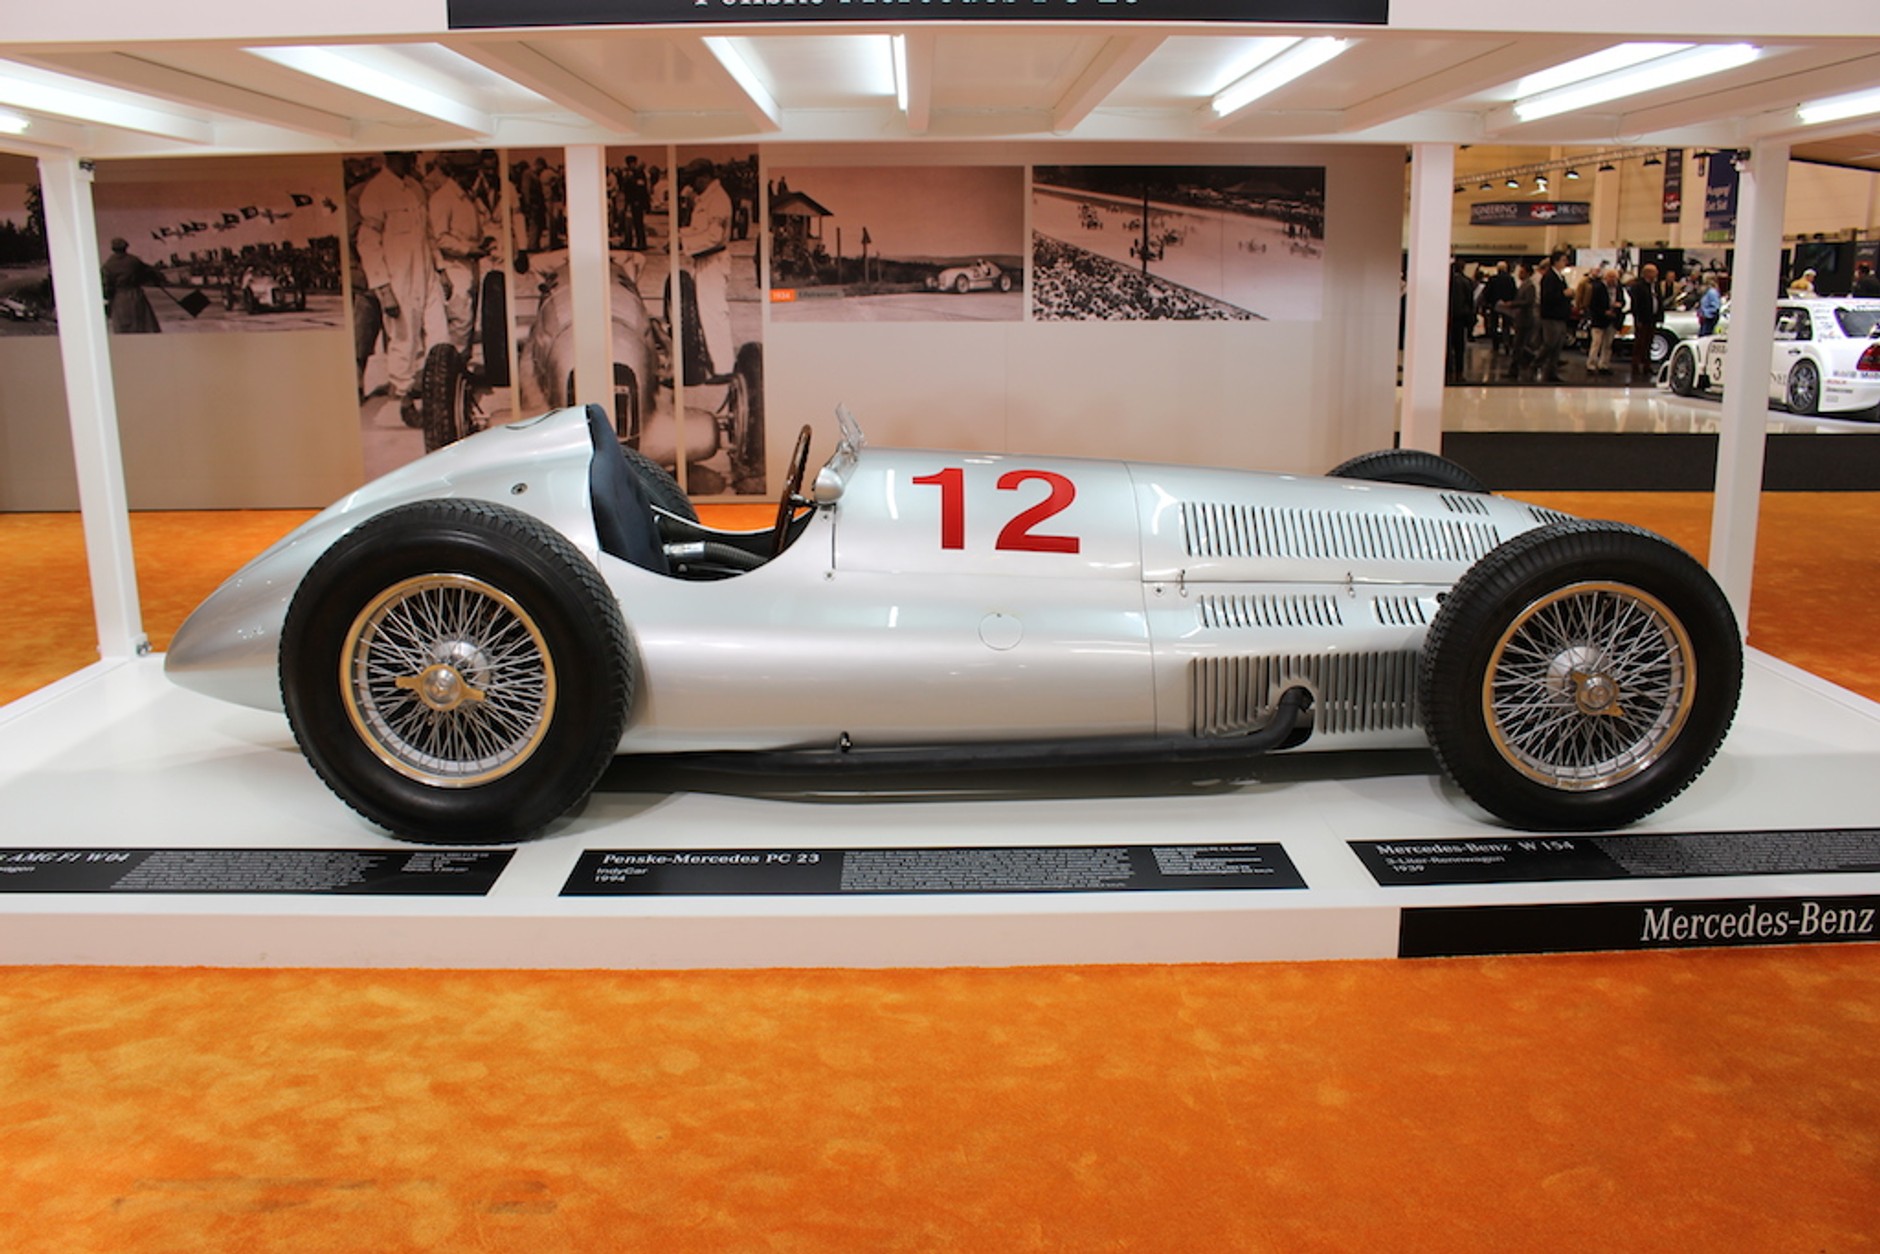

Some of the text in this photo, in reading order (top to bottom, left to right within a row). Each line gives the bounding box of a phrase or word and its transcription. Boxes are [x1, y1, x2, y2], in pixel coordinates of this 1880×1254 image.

[1713, 357, 1722, 381] 3
[912, 468, 1080, 554] 12
[1376, 843, 1512, 855] Mercedes-Benz
[1518, 841, 1536, 850] W
[602, 853, 820, 864] Penske-Mercedes PC 23
[596, 867, 648, 875] IndyCar
[1640, 902, 1876, 942] Mercedes-Benz
